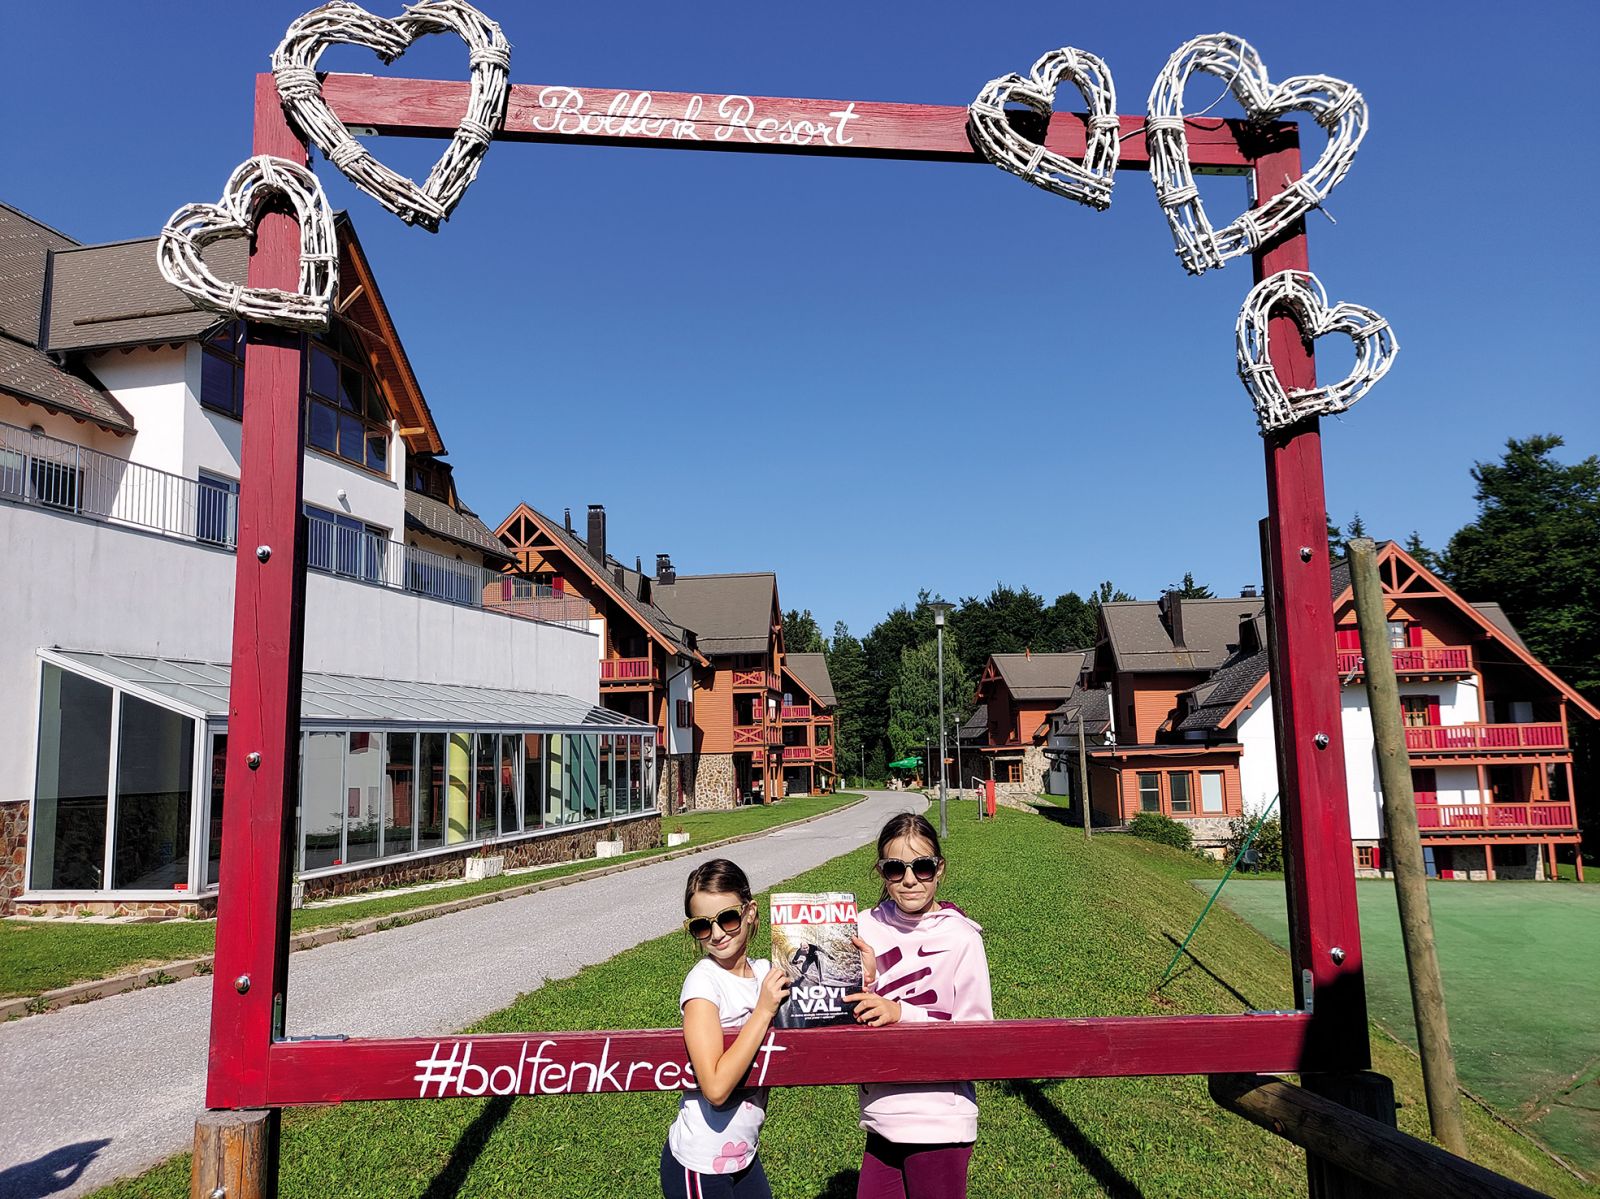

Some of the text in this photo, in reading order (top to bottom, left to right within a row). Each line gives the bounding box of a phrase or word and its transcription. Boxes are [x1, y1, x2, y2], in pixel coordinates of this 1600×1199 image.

[714, 94, 861, 146] Resort
[770, 904, 858, 925] MLADINA
[791, 985, 846, 1001] NOVI
[797, 999, 842, 1013] VAL
[413, 1031, 788, 1098] #bolfenkrest
